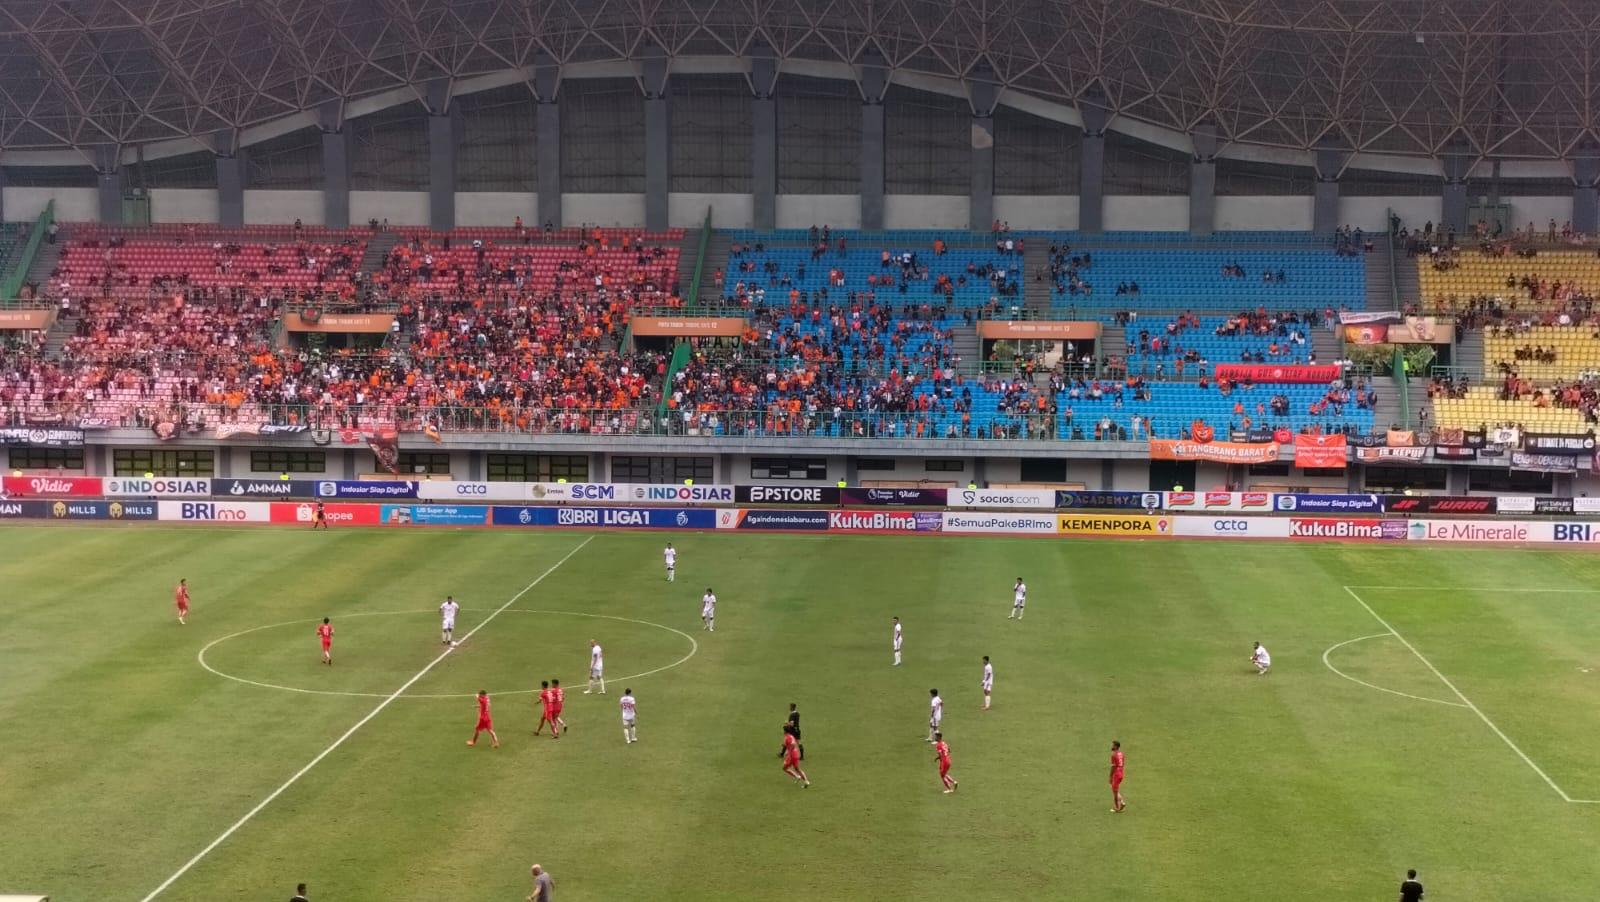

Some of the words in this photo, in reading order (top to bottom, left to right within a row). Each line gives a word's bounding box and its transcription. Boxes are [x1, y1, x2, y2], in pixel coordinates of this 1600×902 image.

[1188, 445, 1236, 457] TANGERANG
[1238, 448, 1265, 457] BARAT
[31, 478, 73, 493] Vidio
[123, 481, 207, 493] INDOSIAR
[247, 483, 291, 493] AMMAN
[457, 484, 486, 494] octa
[572, 484, 614, 499] SCM
[649, 487, 731, 500] INDOSIAR
[765, 488, 821, 501] PSTORE
[899, 490, 920, 498] Vidio
[1331, 500, 1348, 508] Siap
[1349, 500, 1373, 508] Digital
[1429, 501, 1489, 509] JUARA
[69, 506, 96, 514] MILLS
[125, 506, 152, 515] MILLS
[574, 509, 598, 523] BRI
[747, 515, 827, 524] ligaindonesiabaru.com
[830, 513, 916, 529] KukuBima
[948, 518, 1052, 529] #SemuaPakeBRImo
[1062, 520, 1152, 531] KEMENPORA
[1214, 520, 1248, 530] octa
[1290, 521, 1382, 537] KukuBima
[1428, 523, 1448, 539] Le
[1452, 524, 1527, 540] Minerale
